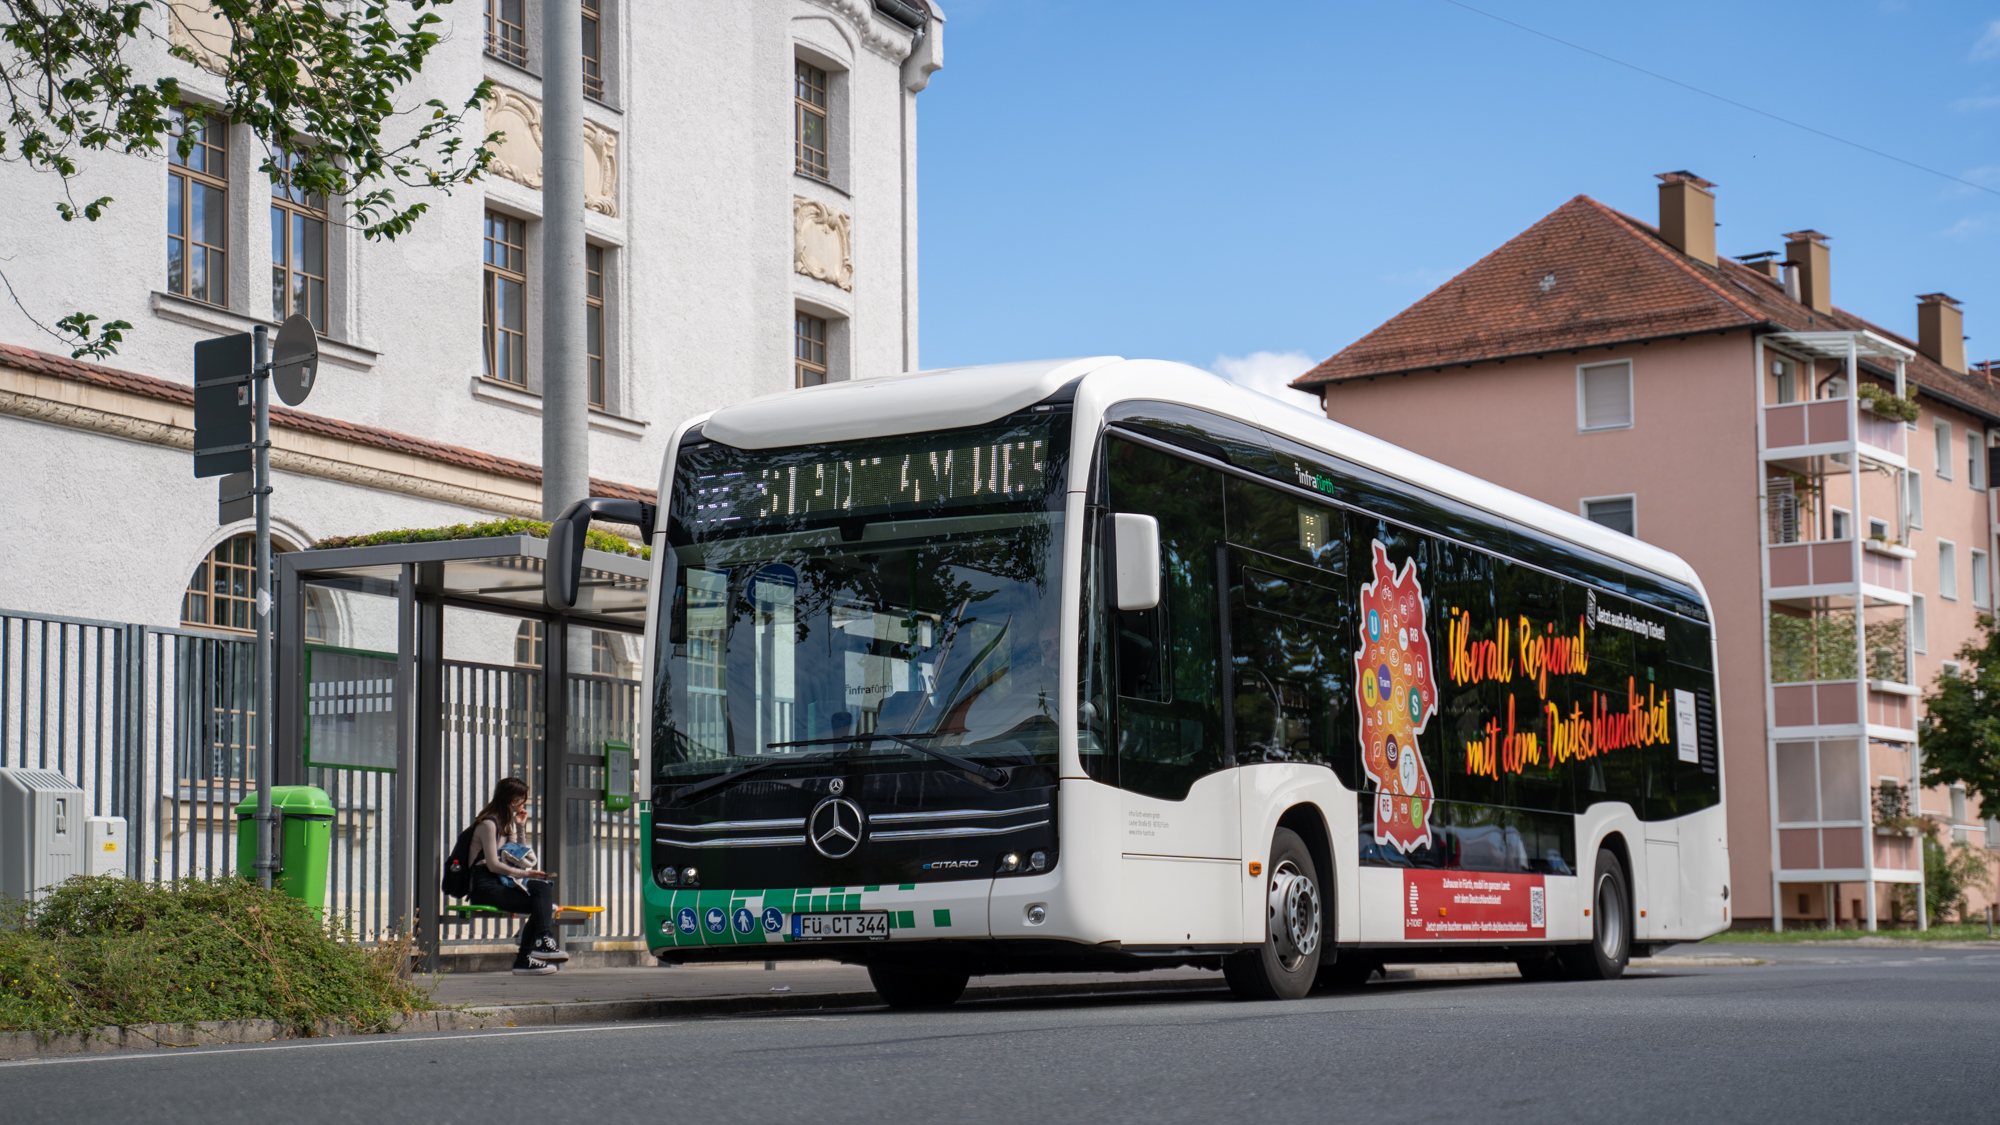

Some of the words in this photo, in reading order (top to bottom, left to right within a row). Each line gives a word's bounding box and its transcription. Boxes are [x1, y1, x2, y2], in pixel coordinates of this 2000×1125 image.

[1298, 470, 1334, 495] infrafürth
[1400, 603, 1407, 616] RE
[1370, 615, 1378, 635] U
[1383, 618, 1389, 634] H
[1393, 614, 1398, 628] S
[1596, 606, 1612, 625] Jetzt
[1611, 611, 1625, 629] auch
[1624, 613, 1633, 631] als
[1632, 615, 1649, 640] Handy
[1647, 620, 1666, 641] Ticket!
[1409, 627, 1419, 642] RB
[1449, 606, 1514, 687] Überall
[1518, 614, 1589, 700] Regional
[1403, 663, 1412, 676] RB
[1416, 661, 1423, 678] H
[1366, 676, 1374, 699] H
[1379, 676, 1391, 688] Tram
[1412, 694, 1419, 716] S
[1377, 710, 1382, 725] S
[1387, 710, 1393, 724] U
[1466, 716, 1501, 781] mit
[1502, 692, 1542, 775] dem
[1544, 675, 1670, 770] Deutschlandticket
[1393, 779, 1399, 795] S
[1420, 780, 1426, 795] U
[1382, 798, 1390, 812] RE
[1400, 803, 1408, 814] RB
[922, 859, 979, 869] eCITARO
[1442, 878, 1459, 889] Zuhause
[1461, 893, 1469, 903] dem
[802, 917, 822, 934] FÜ
[832, 916, 853, 934] CT
[856, 916, 886, 934] 344
[1425, 921, 1436, 932] Jetzt
